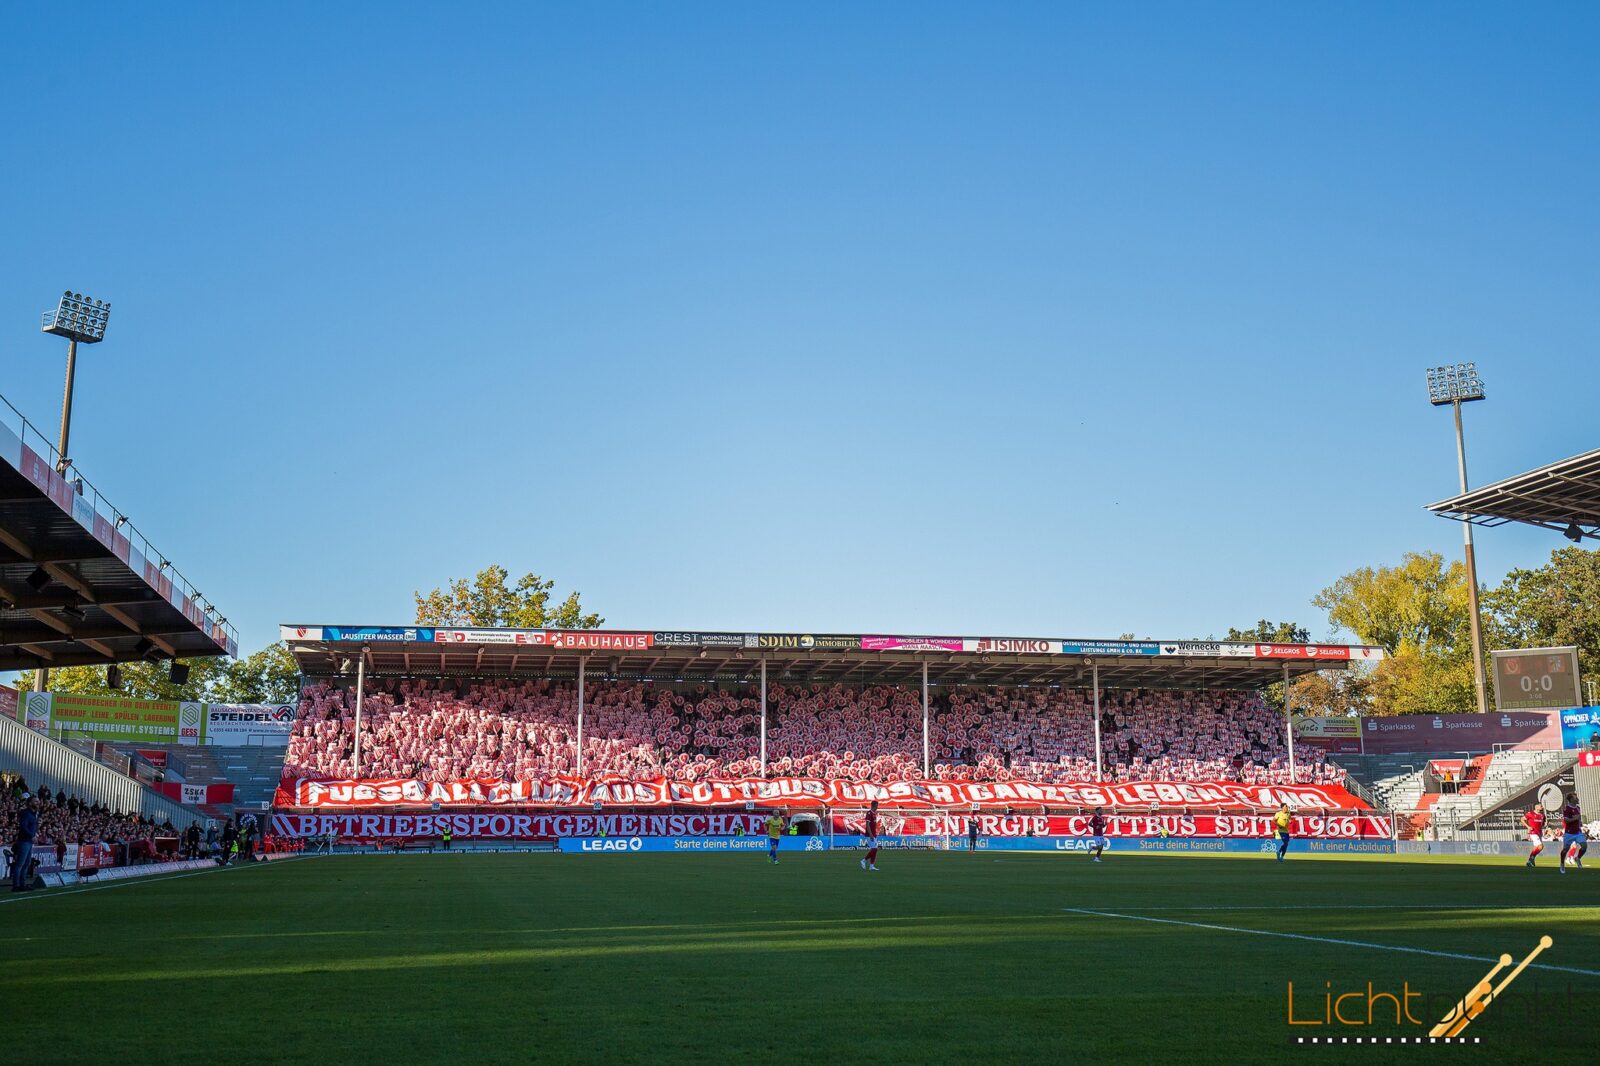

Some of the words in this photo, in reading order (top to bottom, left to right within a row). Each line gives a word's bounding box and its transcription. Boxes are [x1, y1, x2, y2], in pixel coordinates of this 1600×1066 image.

[567, 635, 647, 648] BAUHAUS
[654, 633, 699, 642] CREST
[759, 636, 798, 647] SDIM
[994, 640, 1050, 652] ISIMKO
[1178, 643, 1220, 651] Wernecke
[1520, 675, 1553, 692] 0:0
[210, 713, 272, 722] STEIDEL
[54, 720, 176, 735] WWW.GREENEVENT.SYSTEMS
[1380, 722, 1416, 731] Sparkasse
[1446, 720, 1482, 730] Sparkasse
[1514, 719, 1553, 728] Sparkasse
[182, 728, 198, 736] GESS
[184, 787, 204, 796] ZSKA
[671, 778, 826, 803] COTTBUS
[842, 781, 958, 803] UNSER
[967, 783, 1108, 806] GANZES
[1115, 783, 1225, 805] LEBEN
[298, 814, 772, 837] BETRIEBSSPORTGEMEINSCHAF
[1214, 816, 1275, 837] SEIT
[1296, 816, 1357, 837] 1966
[582, 840, 632, 851] LEAG
[674, 840, 700, 849] Starte
[703, 839, 728, 849] deine
[729, 838, 768, 849] Karriere!
[950, 839, 962, 848] bei
[1140, 840, 1164, 850] Starte
[1166, 840, 1188, 850] deine
[1190, 839, 1226, 850] Karriere!
[1310, 841, 1324, 850] Mit
[1326, 840, 1345, 851] einer
[1348, 840, 1391, 854] Ausbildung
[1465, 844, 1491, 854] LEAG
